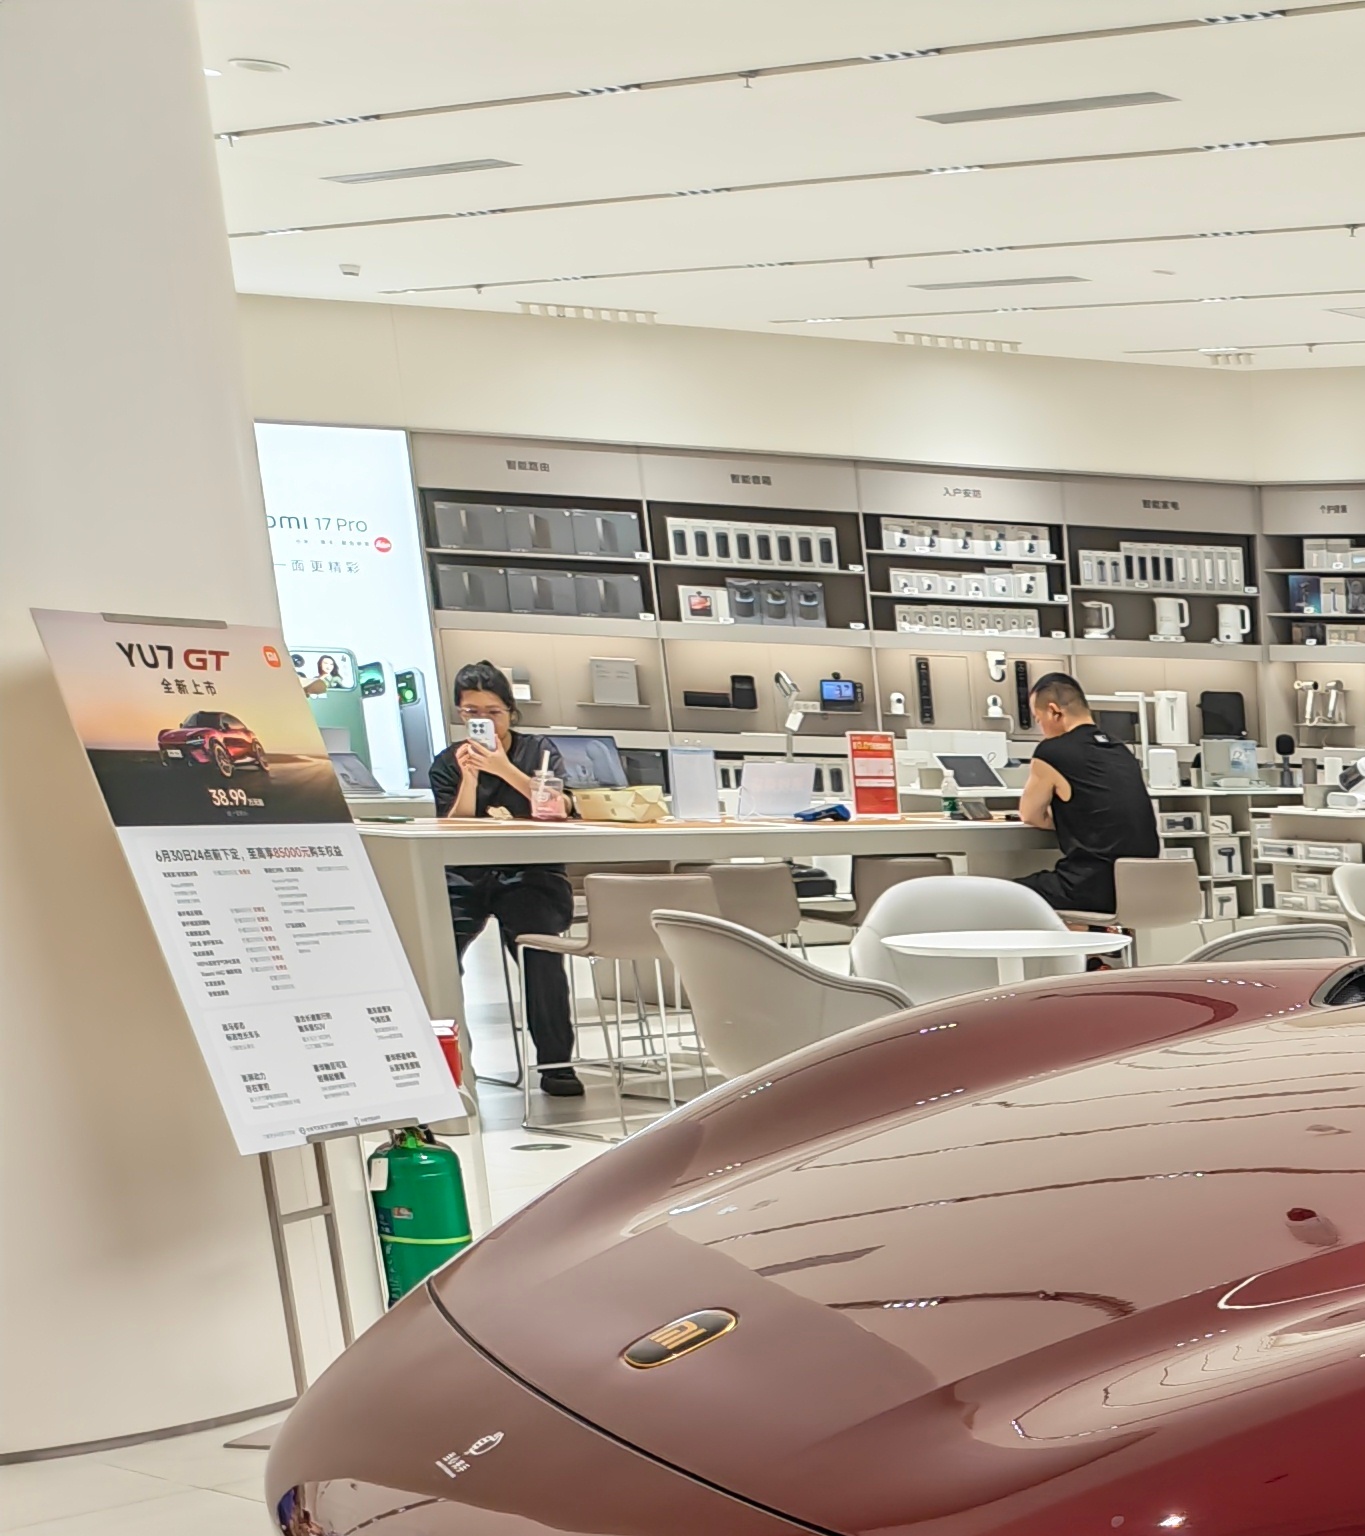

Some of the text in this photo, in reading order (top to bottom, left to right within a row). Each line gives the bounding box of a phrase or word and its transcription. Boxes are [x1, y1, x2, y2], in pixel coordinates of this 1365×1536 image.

[315, 517, 331, 531] 17
[336, 518, 367, 532] Pro
[116, 641, 230, 671] YU7 GT
[161, 678, 217, 696] 全新上市
